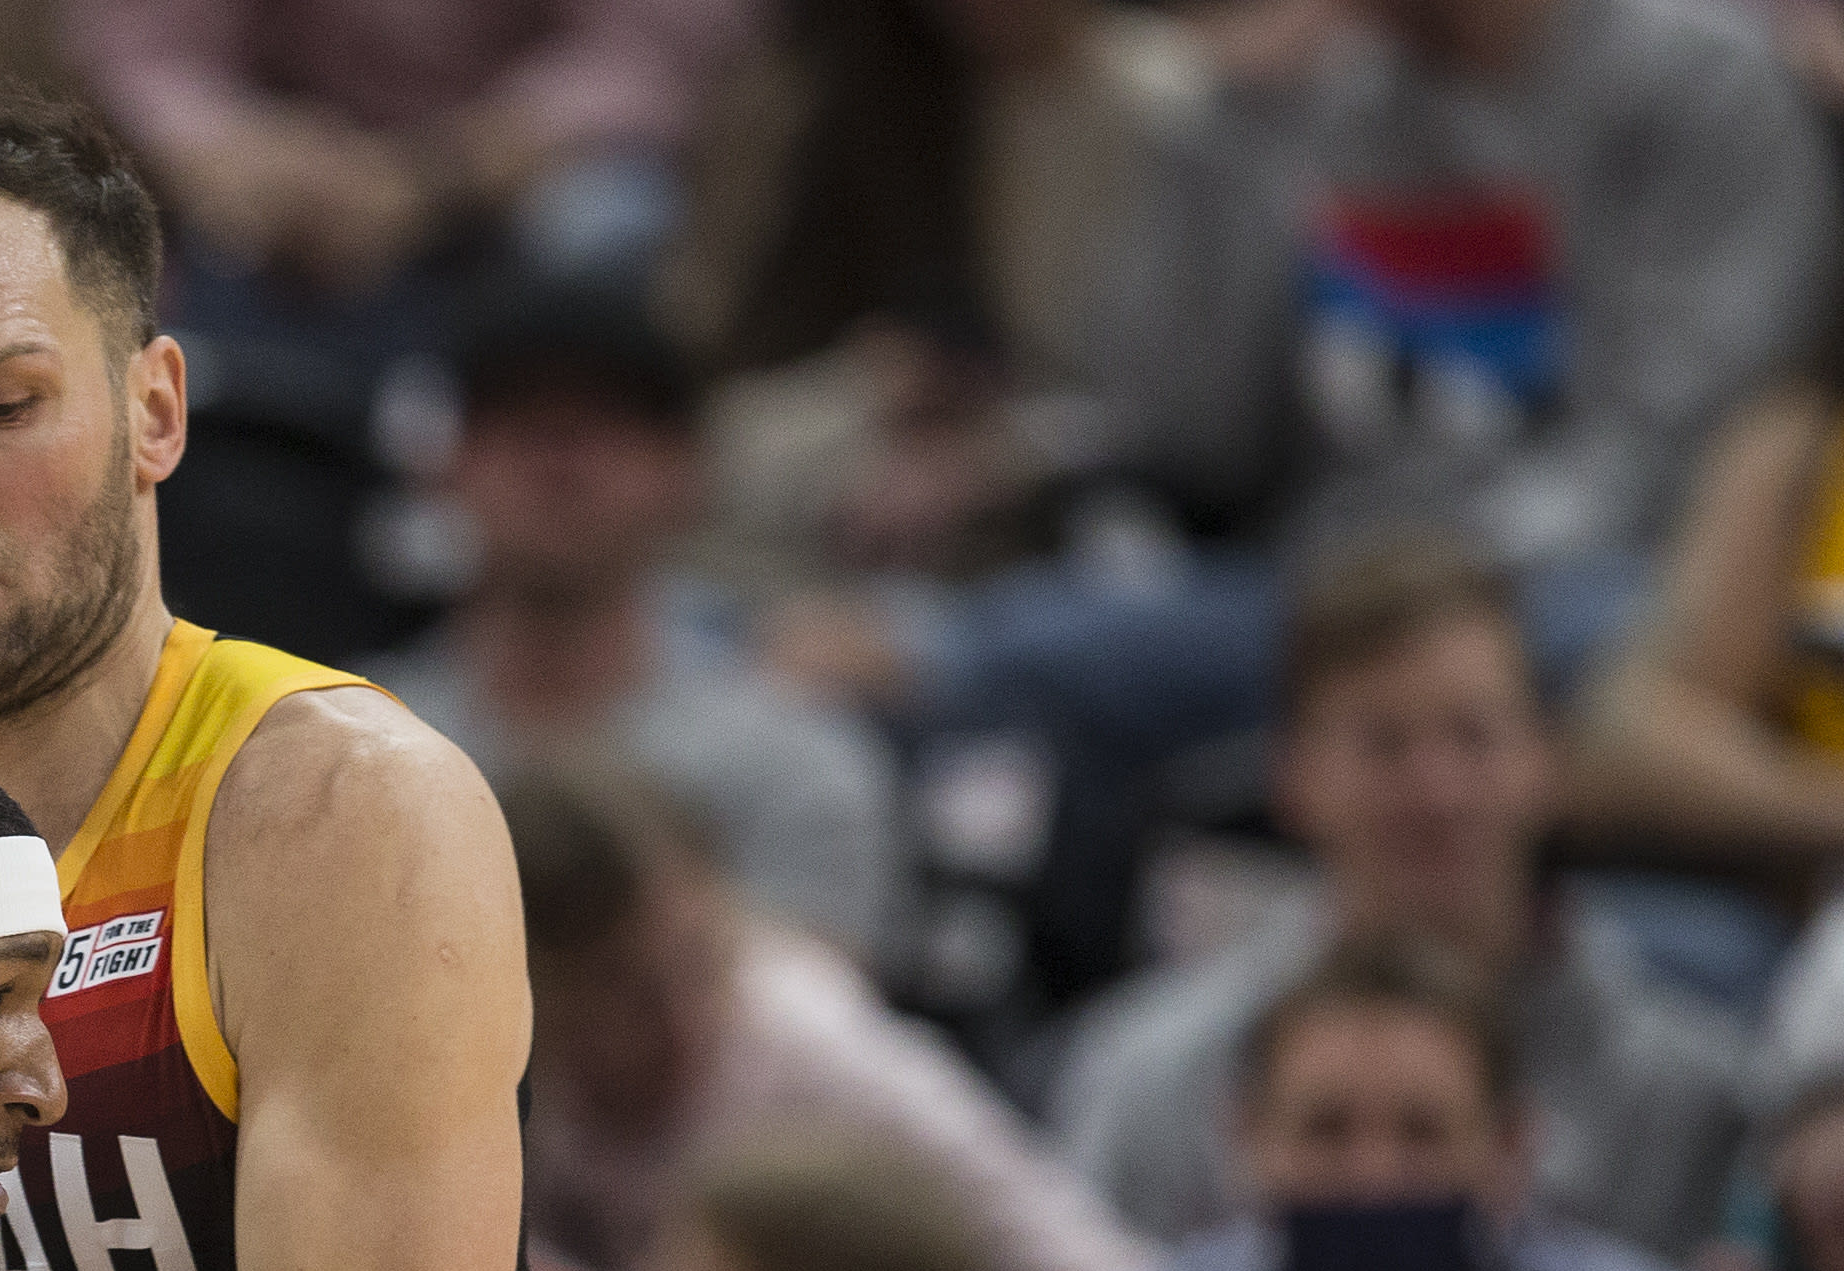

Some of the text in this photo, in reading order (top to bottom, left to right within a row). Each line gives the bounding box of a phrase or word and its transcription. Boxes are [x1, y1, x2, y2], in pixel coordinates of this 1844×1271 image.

[105, 918, 155, 942] FOR THE
[57, 934, 92, 989] 5
[89, 944, 157, 982] FIGHT
